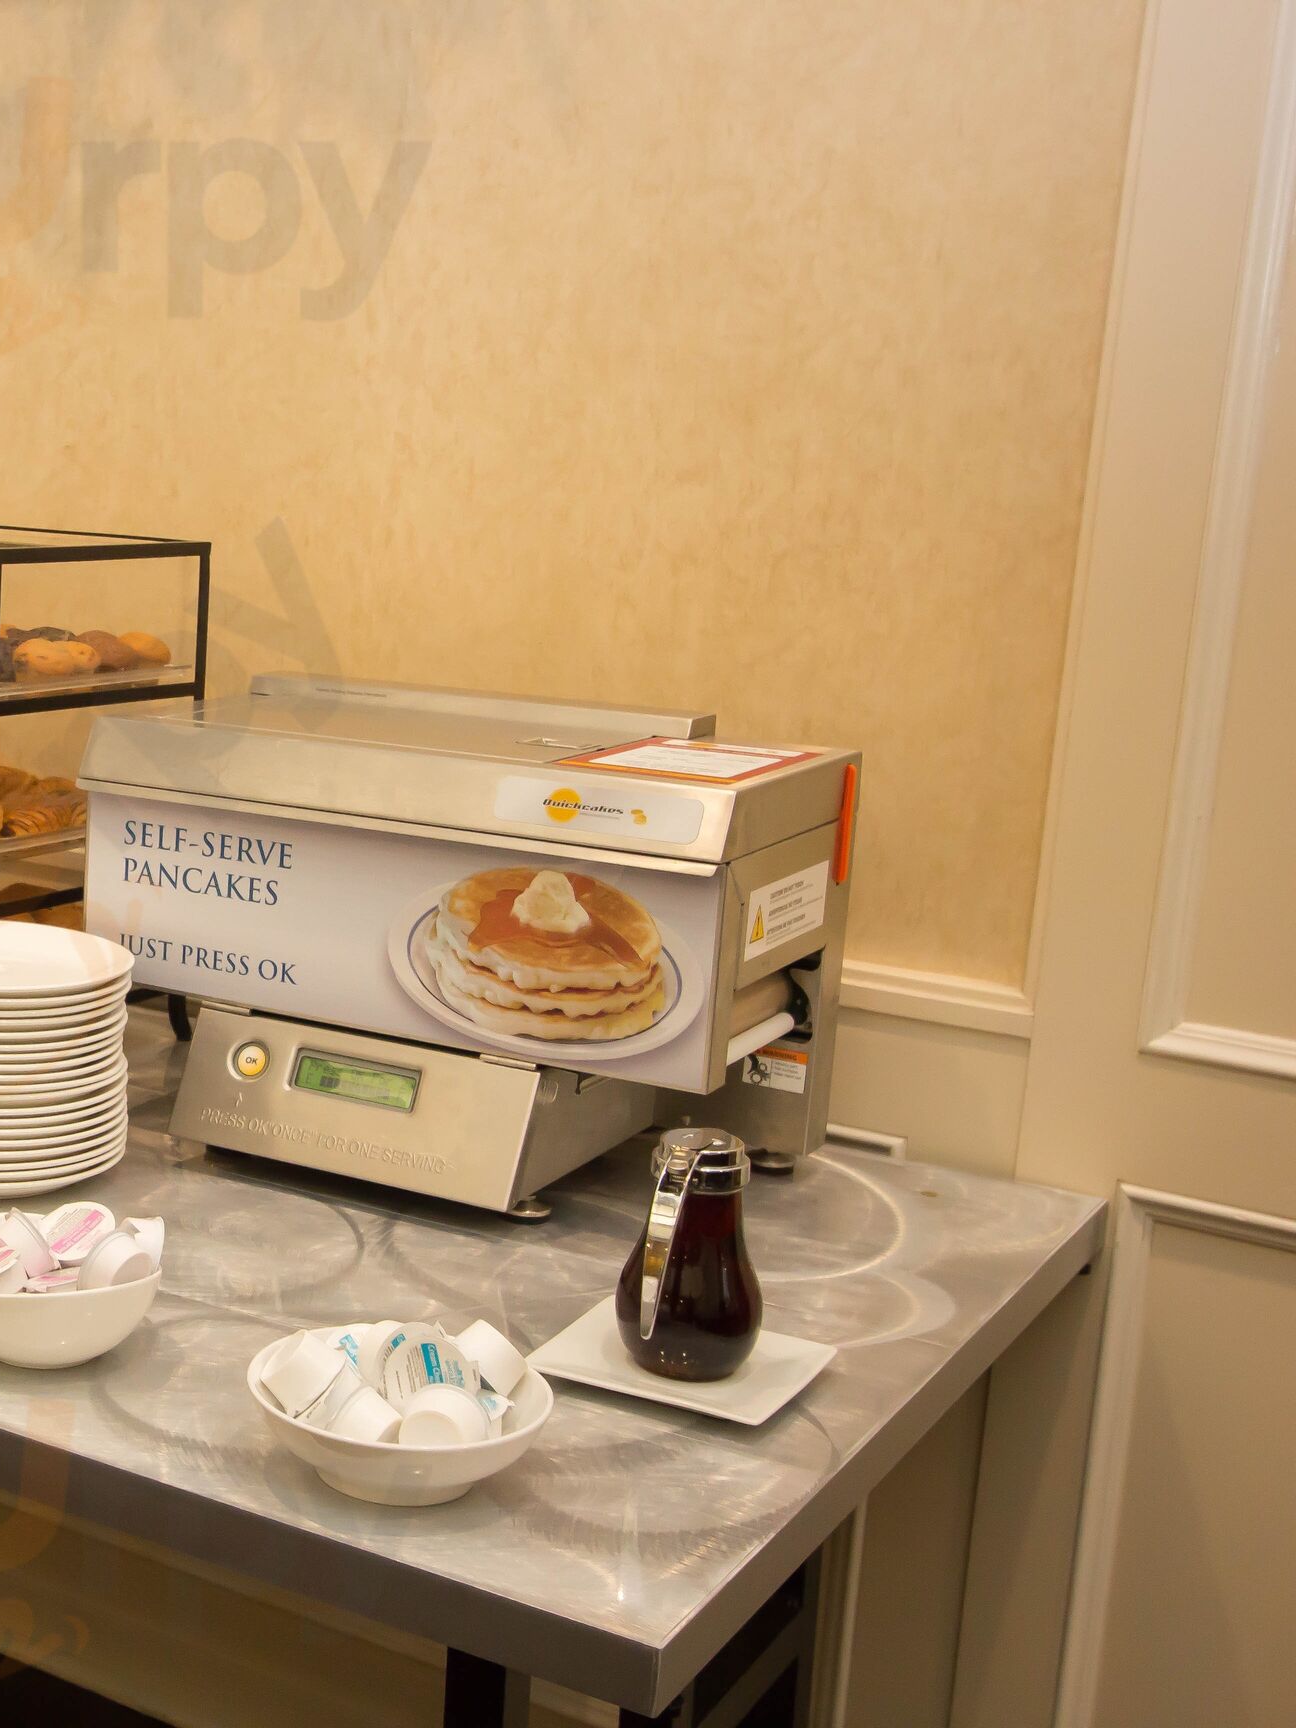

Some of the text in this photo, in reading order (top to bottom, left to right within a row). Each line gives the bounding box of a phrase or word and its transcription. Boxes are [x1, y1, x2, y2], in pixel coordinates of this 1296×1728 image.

[123, 820, 293, 869] SELF-SERVE
[123, 857, 279, 906] PANCAKES
[181, 943, 250, 976] PRESS
[257, 958, 298, 985] OK
[245, 1056, 259, 1066] OK
[201, 1107, 245, 1129] PRESS
[317, 1131, 349, 1153] FOR
[350, 1138, 378, 1161] ONE
[382, 1147, 449, 1174] SERVING
